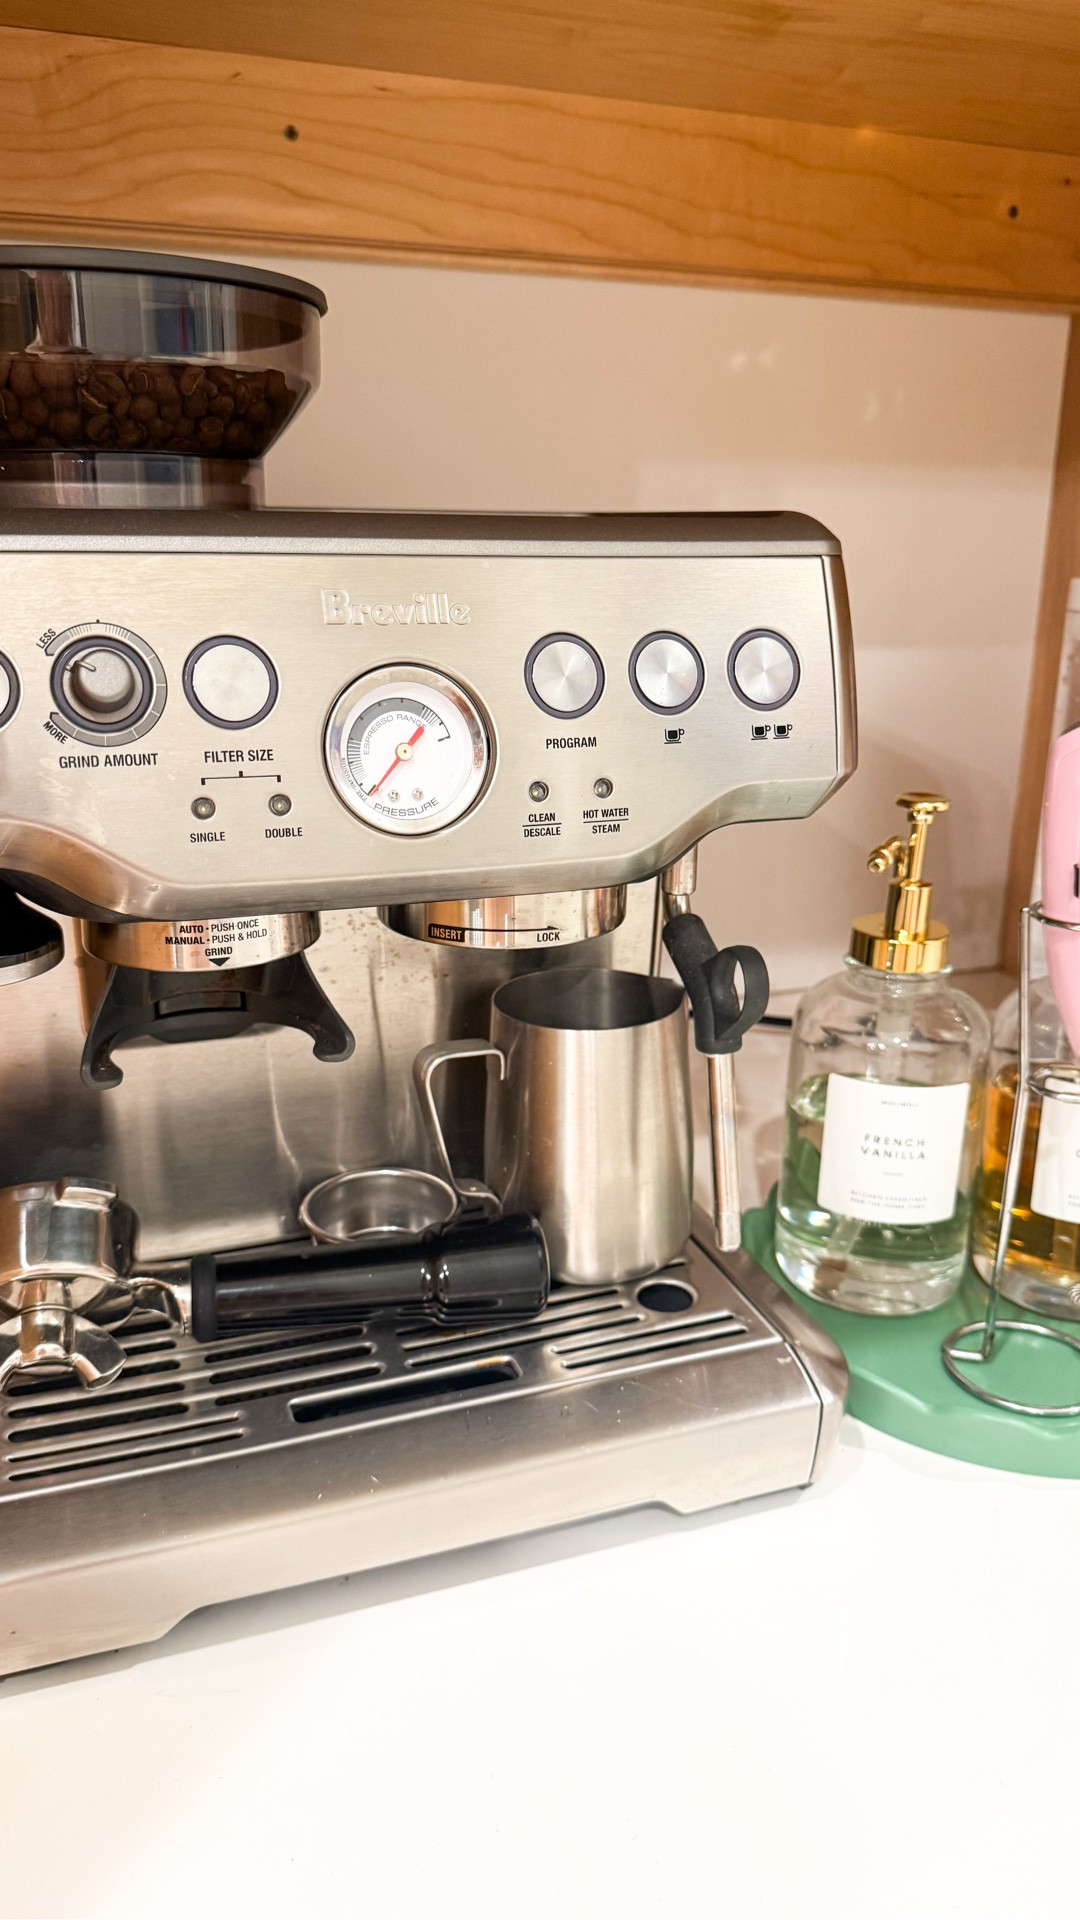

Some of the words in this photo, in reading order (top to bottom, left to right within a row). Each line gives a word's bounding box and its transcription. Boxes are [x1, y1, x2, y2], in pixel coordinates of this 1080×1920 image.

[320, 588, 472, 626] Breville
[36, 628, 57, 650] LESS
[43, 720, 69, 745] MORE
[363, 714, 394, 756] ESPRESSO
[545, 736, 598, 750] PROGRAM
[58, 754, 100, 769] GRIND
[104, 753, 159, 767] AMOUNT
[204, 750, 245, 764] FILTER
[248, 749, 275, 762] SIZE
[373, 797, 440, 817] PRESSURE
[582, 809, 599, 820] HOT
[601, 807, 630, 819] WATER
[528, 812, 556, 823] CLEAN
[265, 827, 304, 839] DOUBLE
[523, 826, 562, 838] DESCALE
[592, 823, 621, 835] STEAM
[190, 831, 226, 844] SINGLE
[179, 925, 204, 934] AUTO
[211, 922, 235, 933] PUSH
[236, 919, 260, 930] ONCE
[430, 926, 462, 940] INSERT
[165, 936, 205, 945] MANUAL
[212, 934, 236, 944] PUSH
[237, 932, 245, 941] &
[246, 928, 268, 939] HOLD
[536, 931, 561, 943] LOCK
[204, 946, 233, 957] GRIND
[864, 1133, 926, 1147] FRENCH
[860, 1146, 926, 1160] VANILLA
